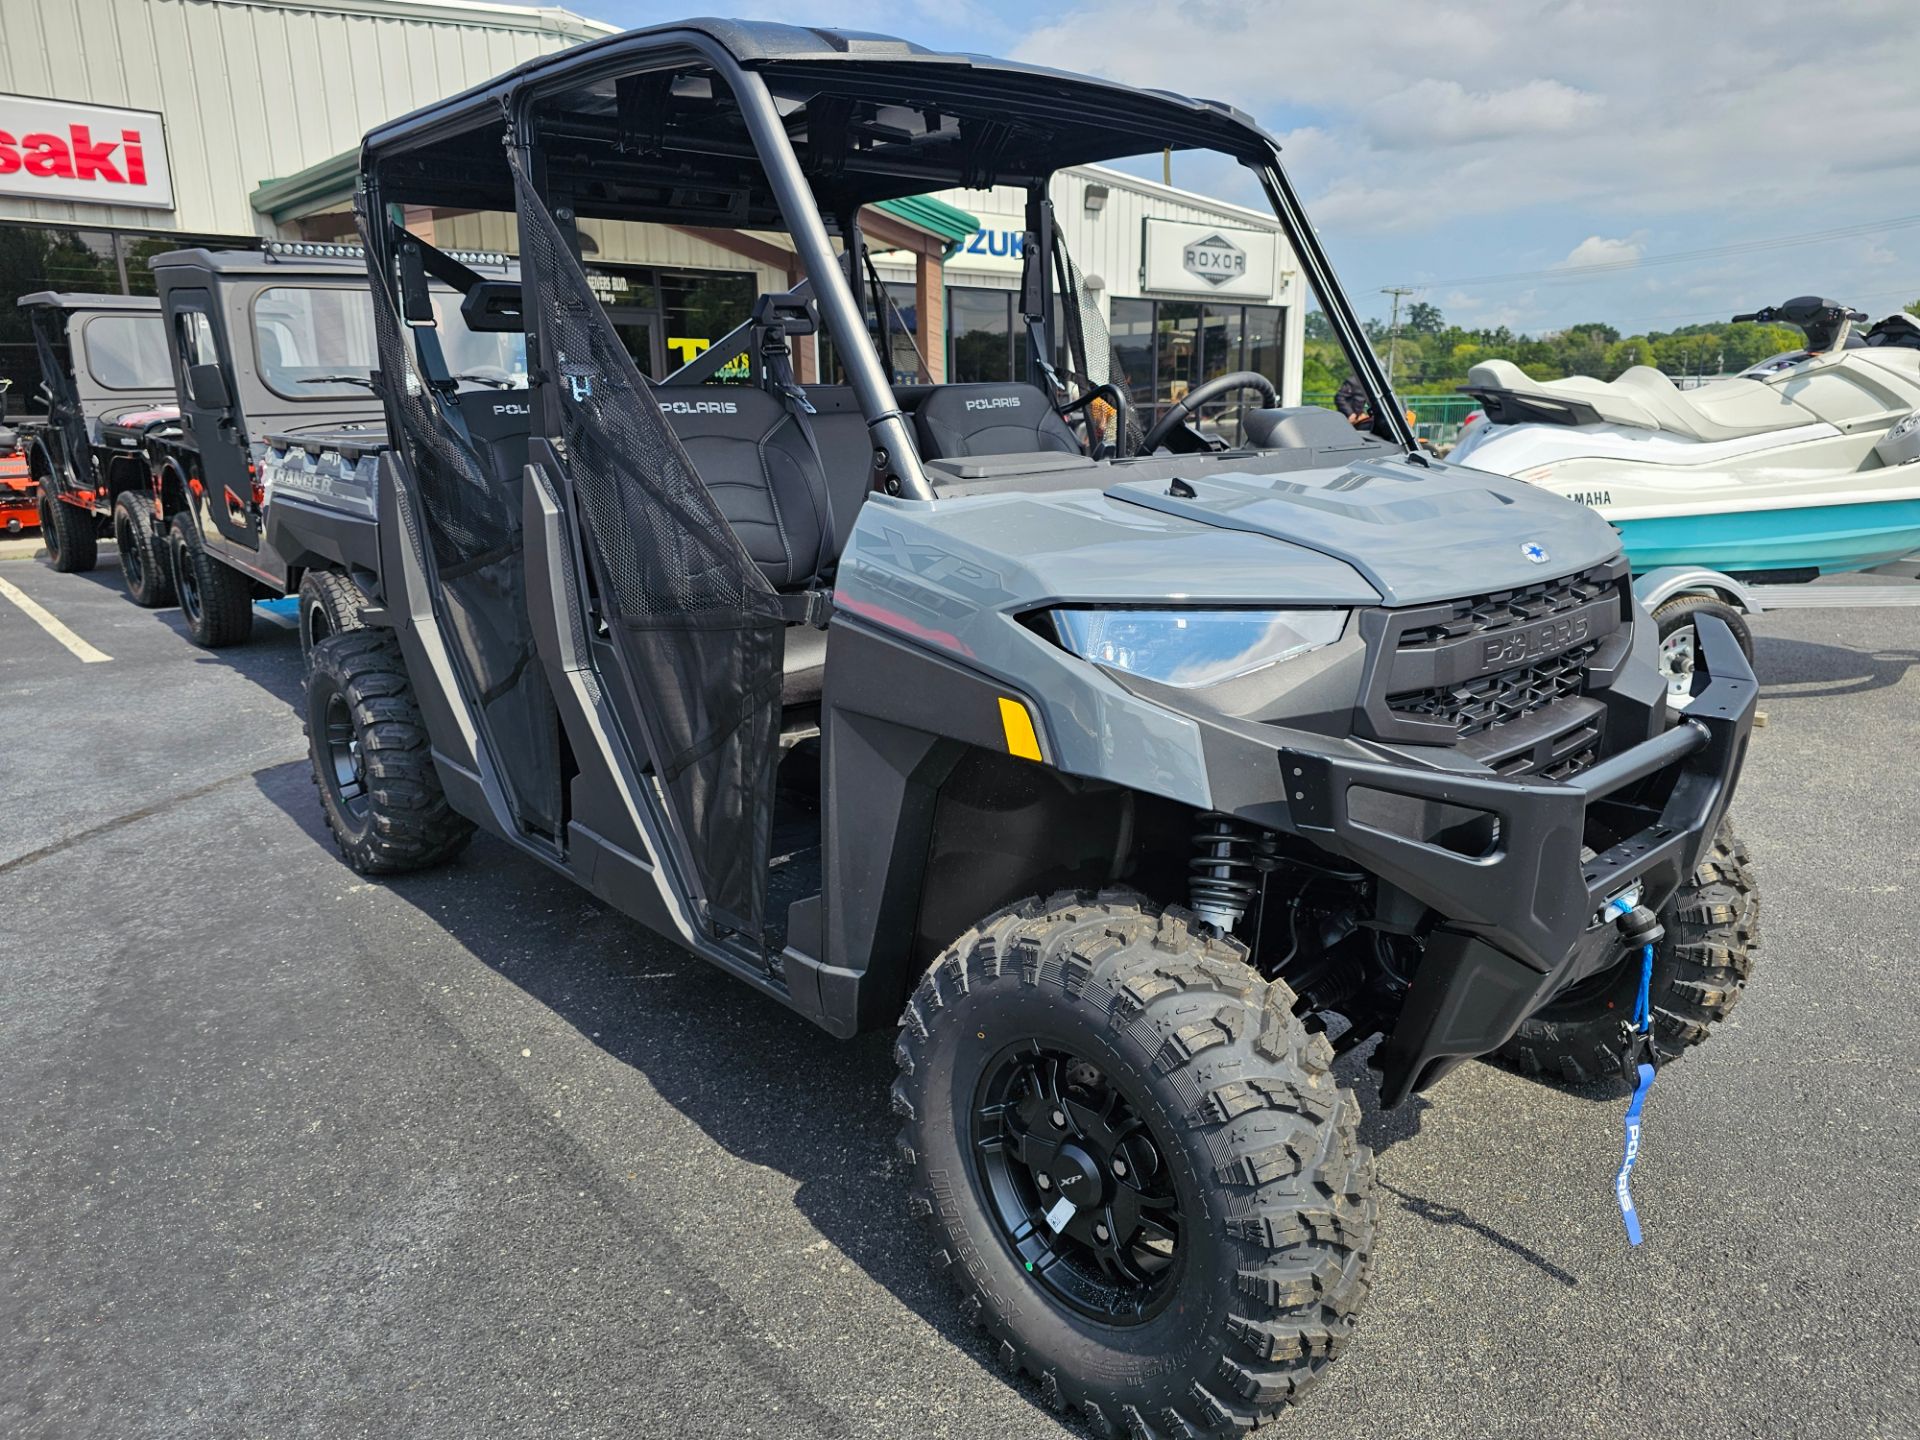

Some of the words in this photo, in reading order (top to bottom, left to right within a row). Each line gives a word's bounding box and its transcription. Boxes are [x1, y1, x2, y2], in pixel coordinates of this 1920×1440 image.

[1186, 250, 1243, 270] ROXOR
[659, 402, 738, 414] POLARIS
[966, 396, 1021, 411] POLARIS
[1567, 491, 1612, 506] MAHA
[856, 526, 1005, 590] XP
[1481, 616, 1588, 670] POLARIS
[1618, 1124, 1639, 1212] POLARIS
[1060, 1174, 1082, 1187] XP
